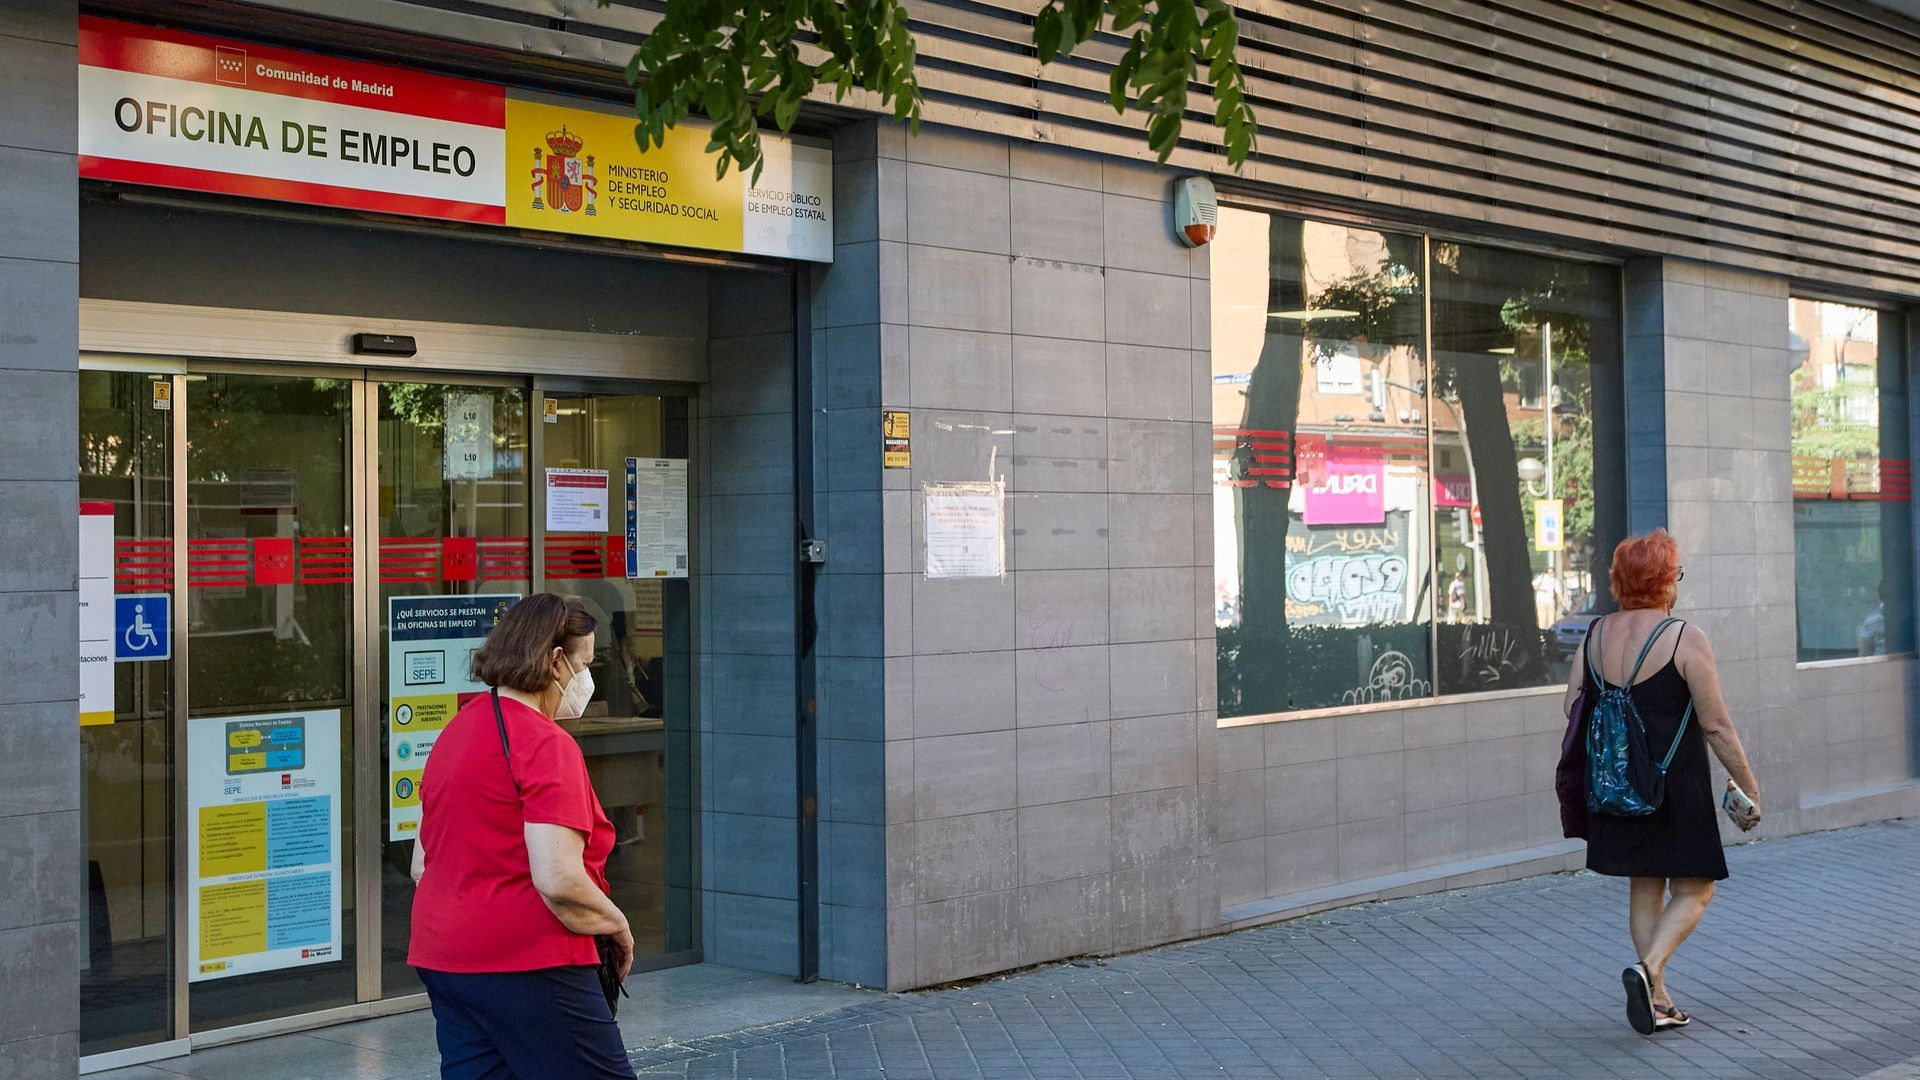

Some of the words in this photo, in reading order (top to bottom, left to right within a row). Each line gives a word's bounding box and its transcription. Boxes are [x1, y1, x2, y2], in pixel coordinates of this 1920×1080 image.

[255, 63, 329, 87] Comunidad
[332, 72, 348, 89] de
[351, 79, 394, 97] Madrid
[114, 97, 269, 151] OFICINA
[281, 120, 328, 158] DE
[340, 129, 477, 177] EMPLEO
[608, 164, 669, 183] MINISTERIO
[608, 179, 624, 193] DE
[626, 182, 667, 199] EMPLEO
[747, 187, 784, 202] SERVICIO
[786, 189, 821, 206] PÚBLICO
[608, 195, 617, 209] Y
[618, 197, 679, 216] SEGURIDAD
[681, 206, 719, 221] SOCIAL
[748, 201, 760, 213] DE
[761, 203, 793, 217] EMPLEO
[794, 207, 827, 222] ESTATAL
[463, 411, 477, 421] L10
[464, 453, 477, 462] L10
[396, 608, 414, 620] ¿QUÉ
[415, 609, 448, 617] SERVICIOS
[408, 621, 438, 629] OFICINAS
[79, 655, 108, 663] taciones
[413, 669, 437, 680] SEPE
[224, 786, 241, 795] SEPE
